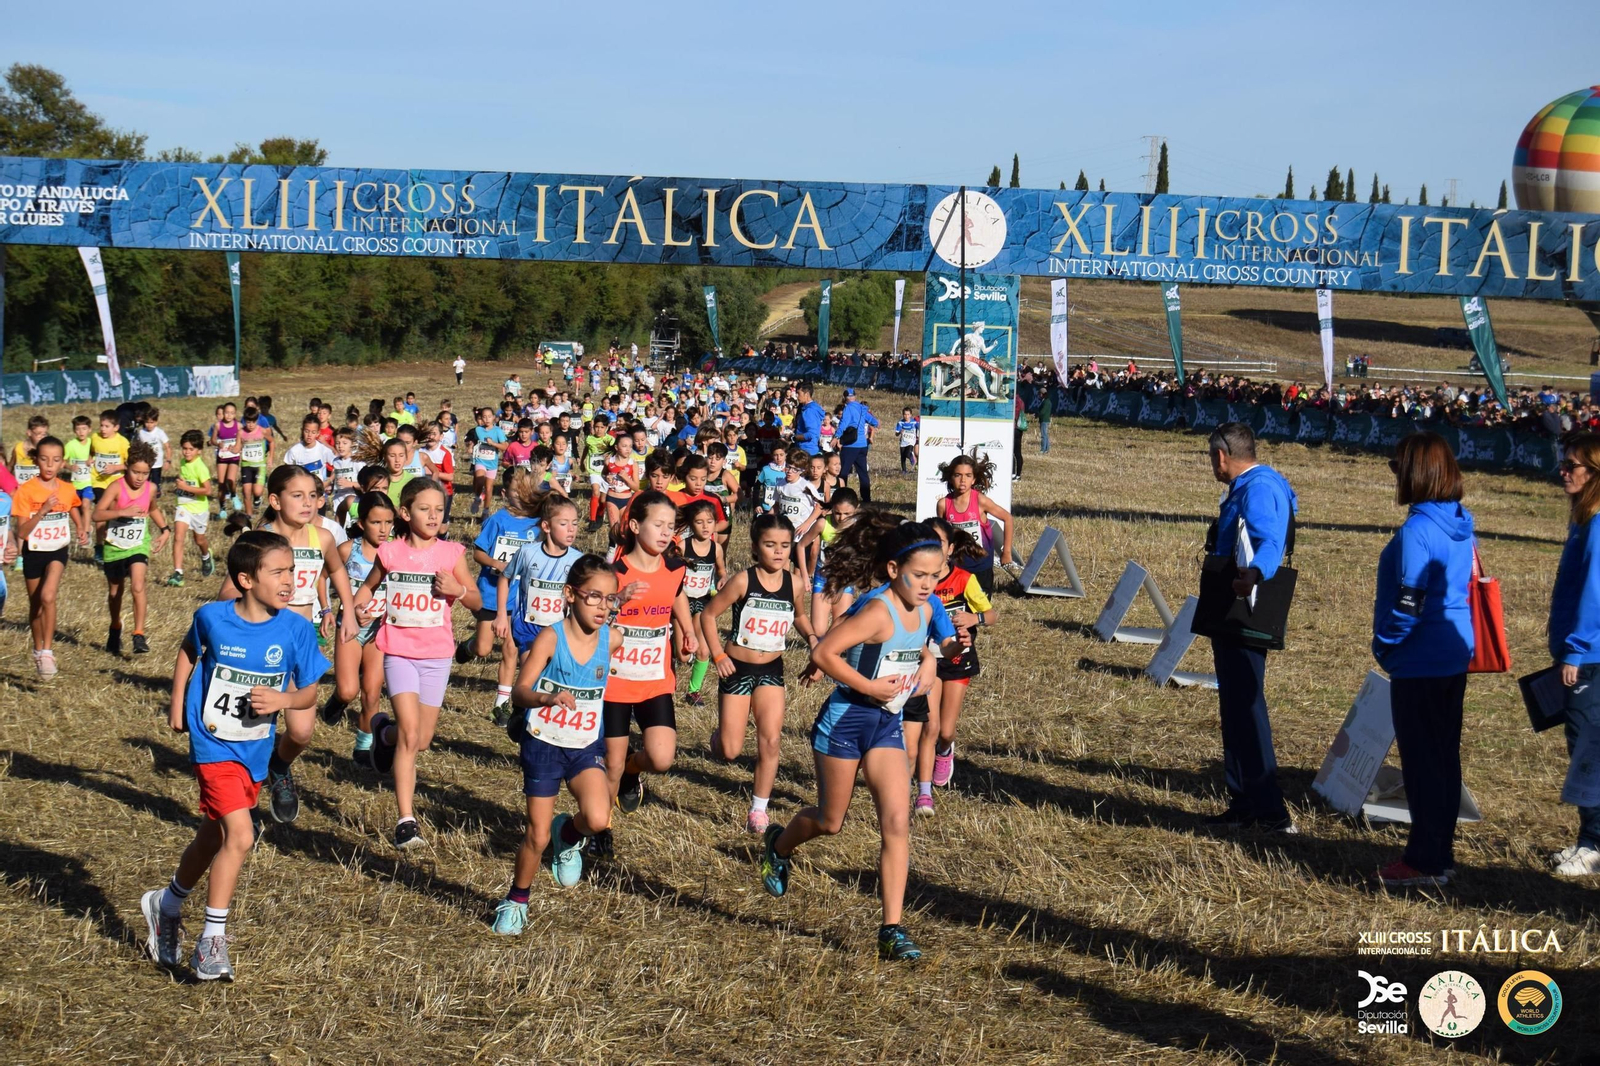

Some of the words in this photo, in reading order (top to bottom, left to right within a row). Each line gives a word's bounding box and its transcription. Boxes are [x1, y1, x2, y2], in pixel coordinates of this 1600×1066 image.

[16, 185, 37, 198] DE
[39, 186, 129, 201] ANDALUCÍA
[0, 198, 21, 211] PO
[23, 199, 36, 211] A
[38, 198, 95, 213] TRAVÉS
[190, 177, 348, 231] XLIII
[353, 182, 475, 215] CROSS
[532, 176, 833, 250] ITÁLICA
[9, 212, 64, 226] CLUBES
[353, 217, 520, 236] INTERNACIONAL
[1050, 202, 1209, 259] XLIII
[1215, 210, 1339, 245] CROSS
[189, 233, 338, 251] INTERNATIONAL
[343, 237, 398, 253] CROSS
[402, 238, 490, 255] COUNTRY
[1395, 209, 1600, 283] ITÁLI
[1214, 244, 1383, 267] INTERNACIONAL
[1048, 258, 1198, 279] INTERNATIONAL
[1203, 265, 1259, 282] CROSS
[1263, 267, 1352, 286] COUNTRY
[974, 291, 1008, 301] Sevilla
[34, 525, 67, 541] 4524
[111, 526, 142, 540] 4187
[296, 570, 319, 589] 57
[367, 599, 387, 612] 22
[391, 592, 442, 613] 4406
[531, 596, 562, 614] 438
[620, 608, 639, 617] Los
[643, 604, 672, 616] Veloc
[744, 617, 789, 637] 4540
[220, 643, 230, 651] Los
[612, 646, 662, 666] 4462
[236, 674, 271, 686] ITÁLICA
[557, 687, 590, 699] ILICA
[213, 692, 272, 720] 43
[537, 704, 597, 731] 4443
